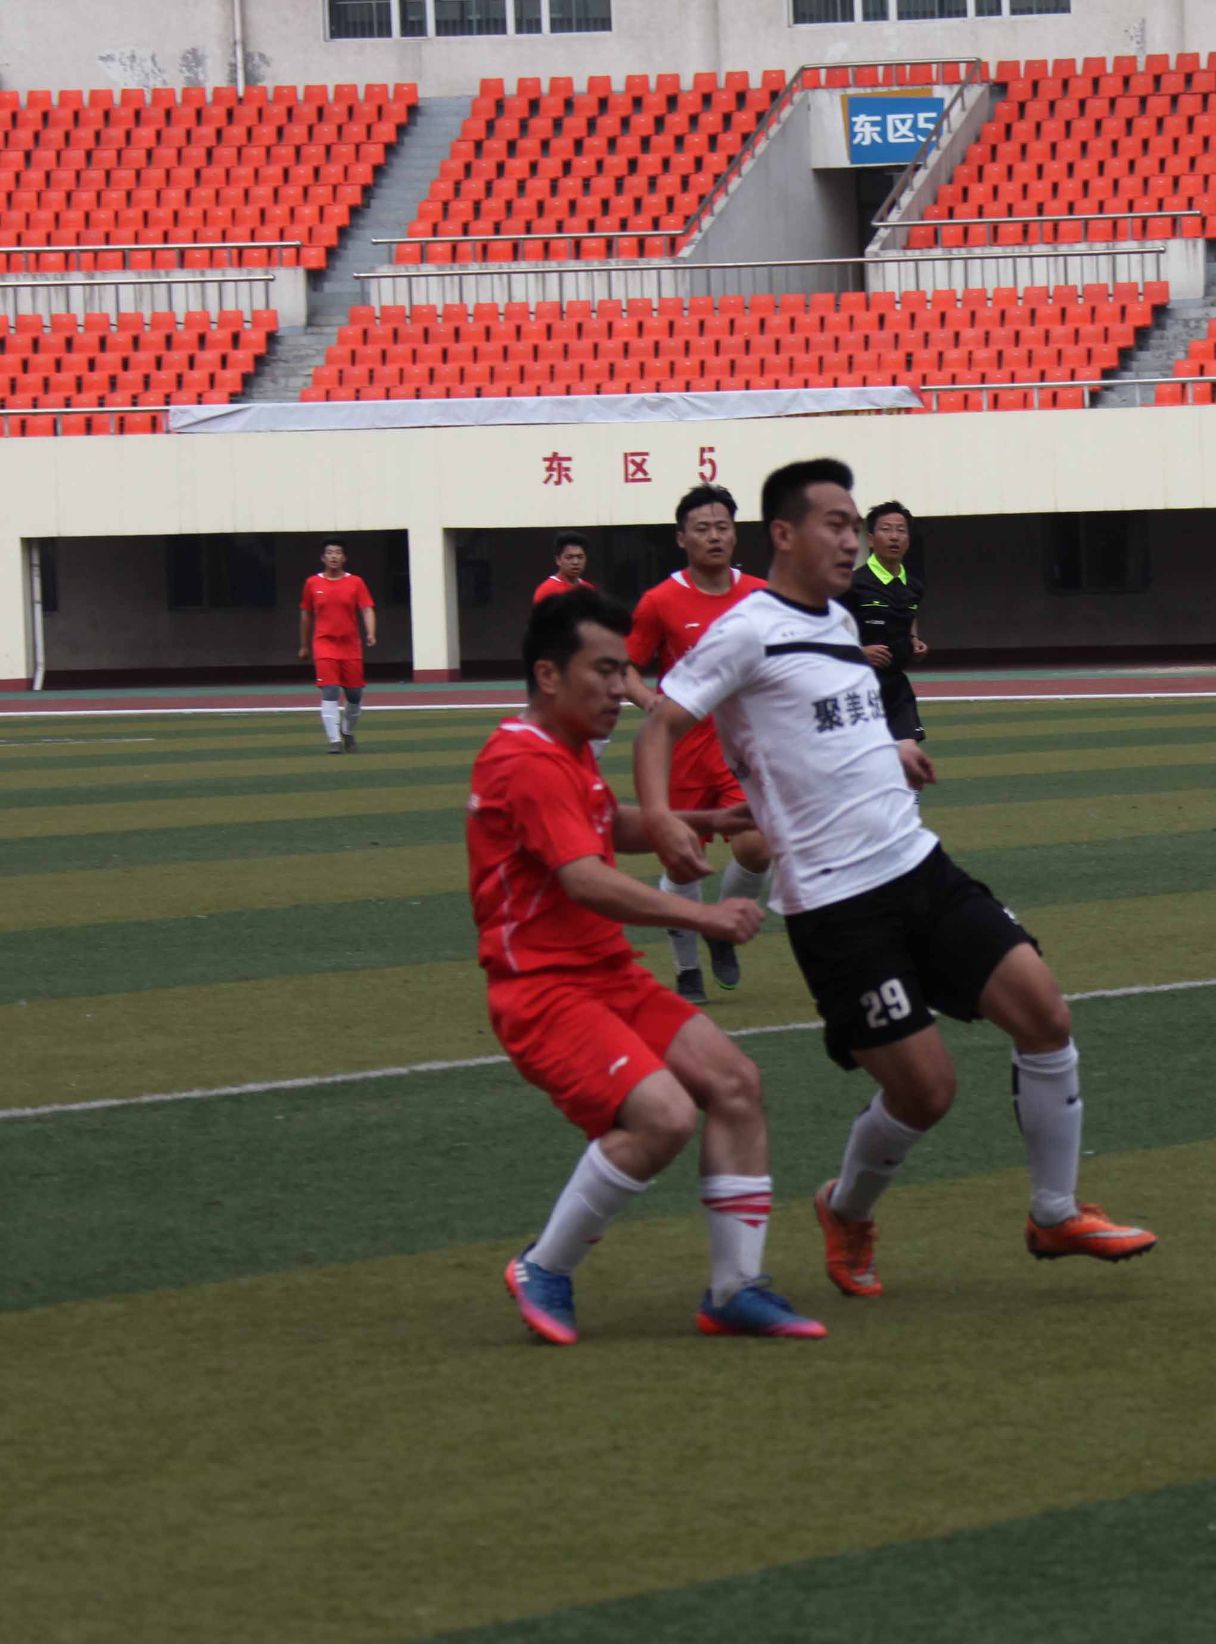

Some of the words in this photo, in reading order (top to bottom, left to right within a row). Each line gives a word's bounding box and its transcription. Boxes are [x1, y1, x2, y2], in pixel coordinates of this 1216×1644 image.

[851, 112, 938, 146] 东区5
[542, 446, 717, 486] 东区5
[859, 978, 912, 1029] 29
